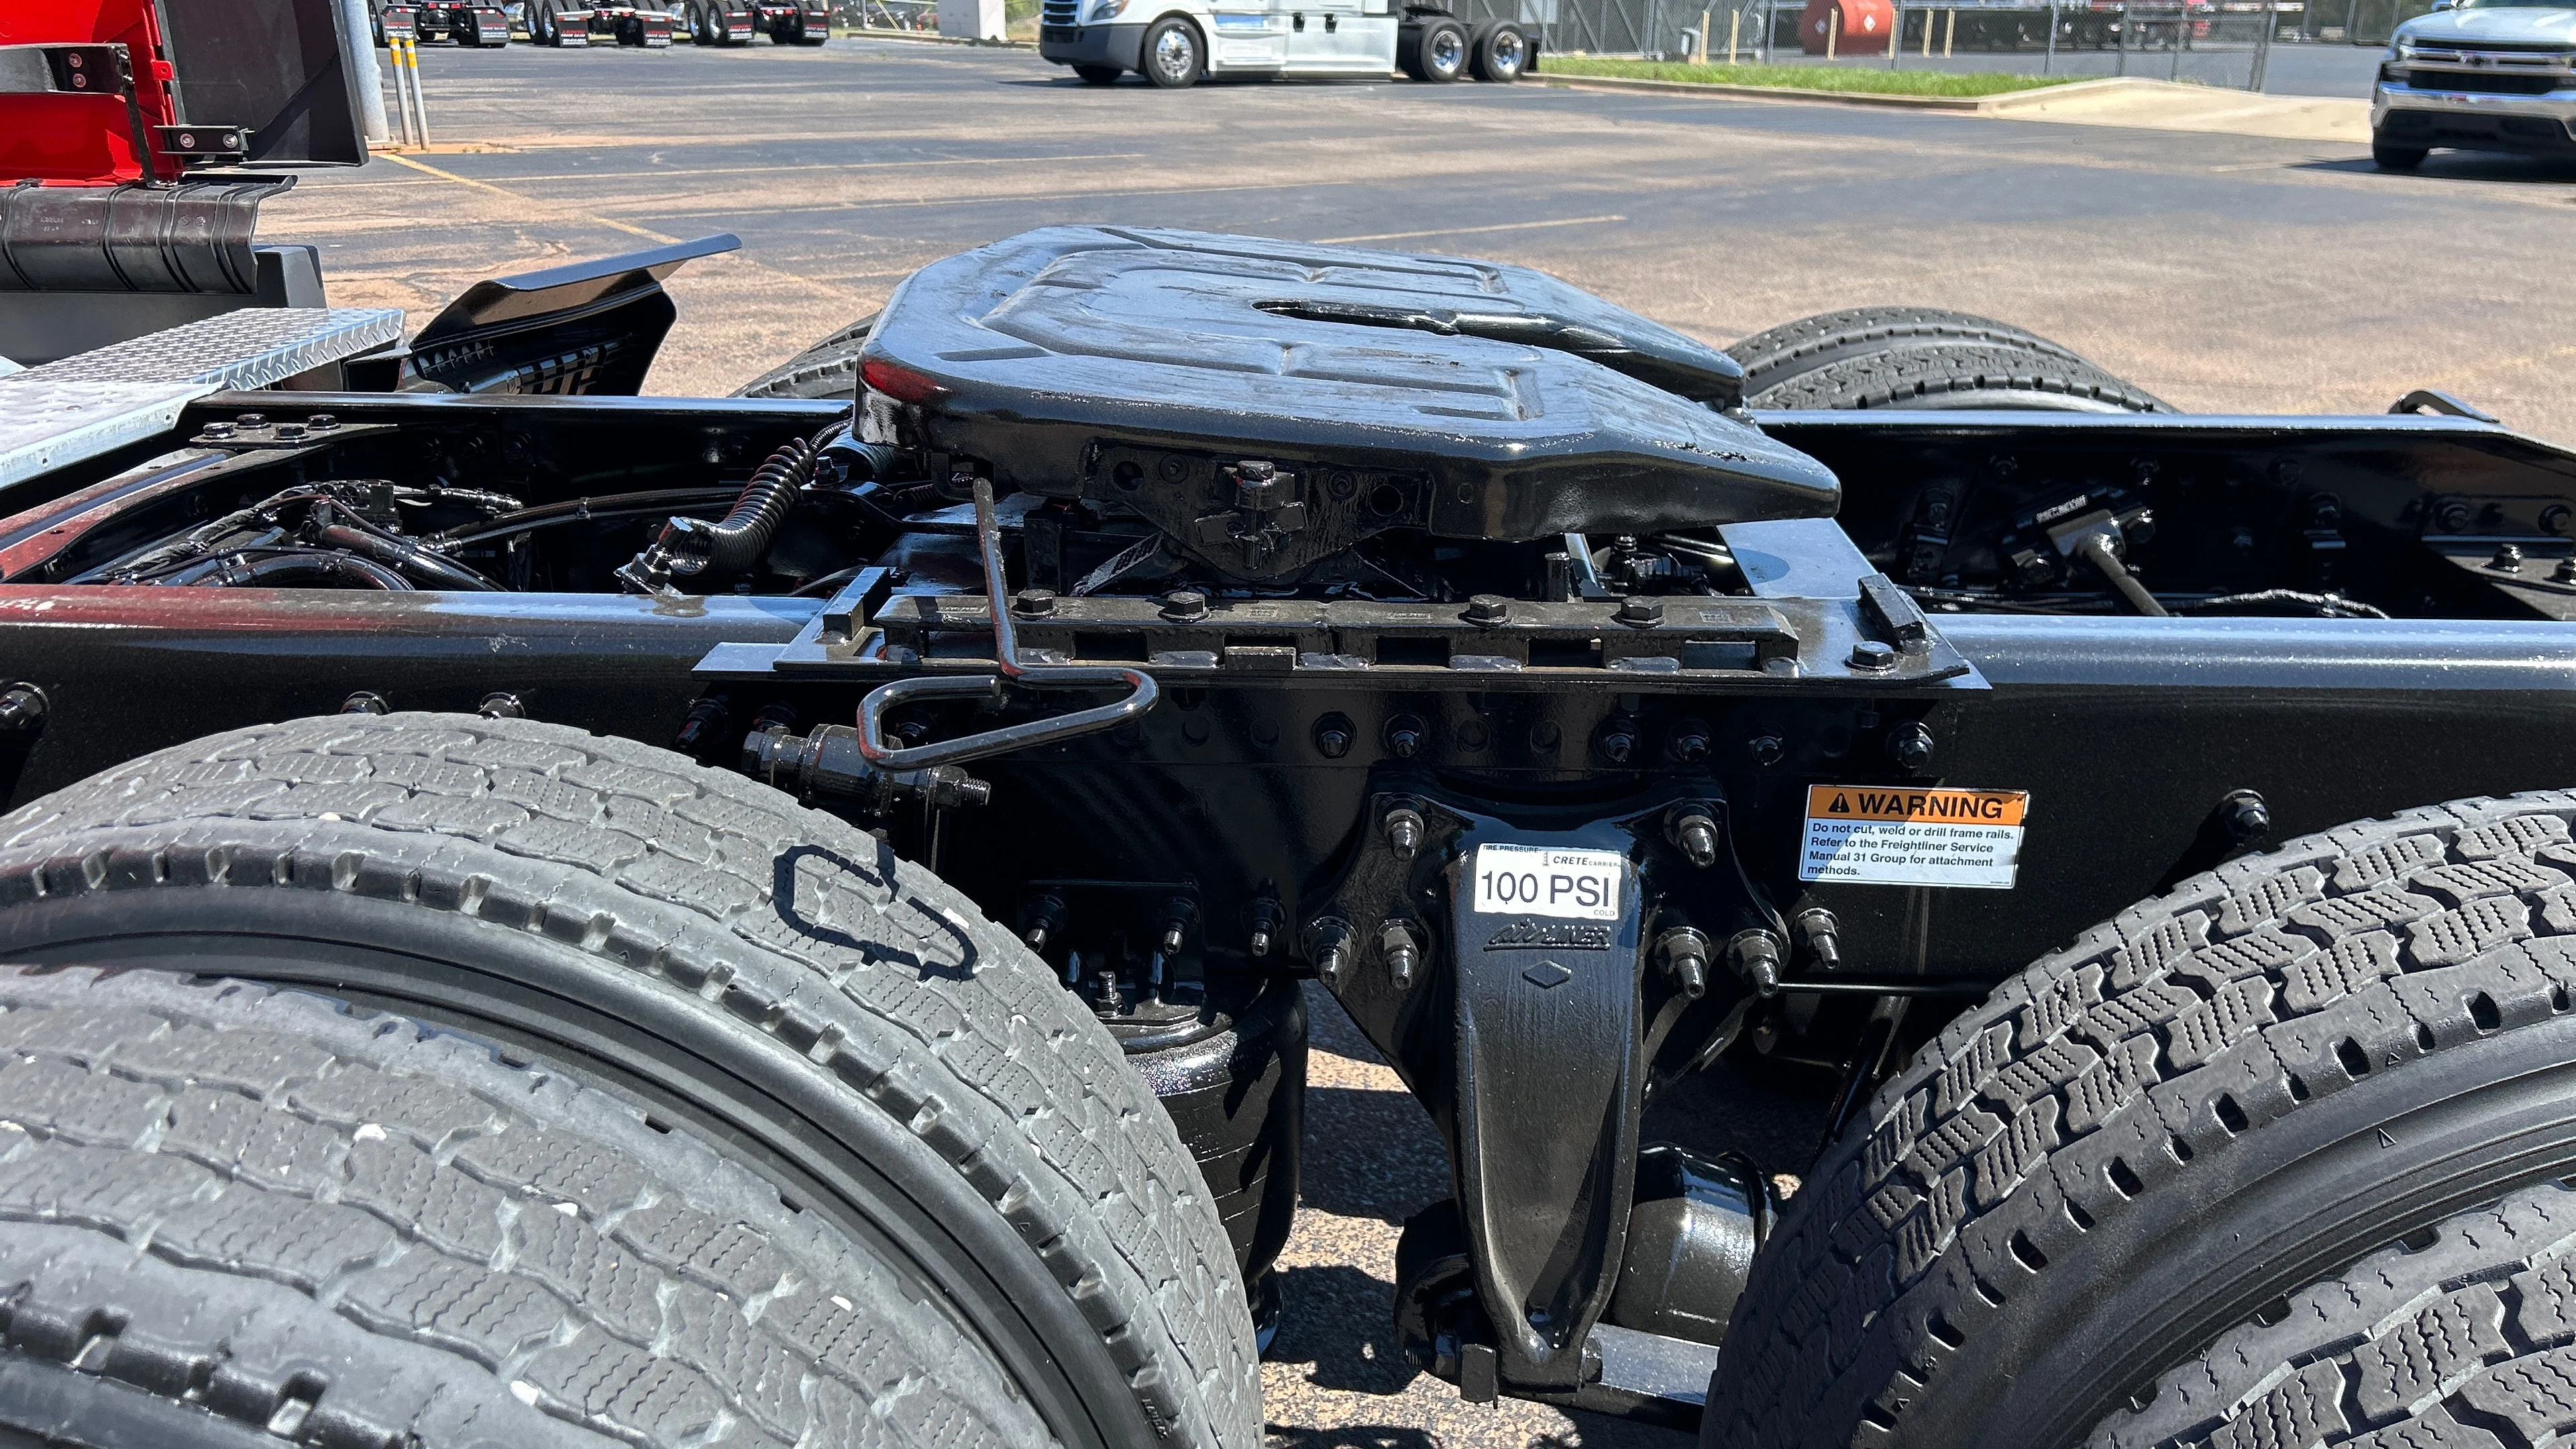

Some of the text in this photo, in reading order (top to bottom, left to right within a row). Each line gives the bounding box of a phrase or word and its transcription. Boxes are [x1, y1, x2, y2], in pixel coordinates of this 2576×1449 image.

[1858, 793, 2003, 818] WARNING
[1813, 822, 2014, 839] Do not cut, weld or drill frame rails.
[1811, 837, 1993, 853] Refer to the Freightliner Service
[1553, 855, 1589, 865] CRETE
[1809, 851, 1994, 867] Manual 31 Group for attachment
[1807, 865, 1860, 875] methods.
[1482, 870, 1609, 907] 100 PSI
